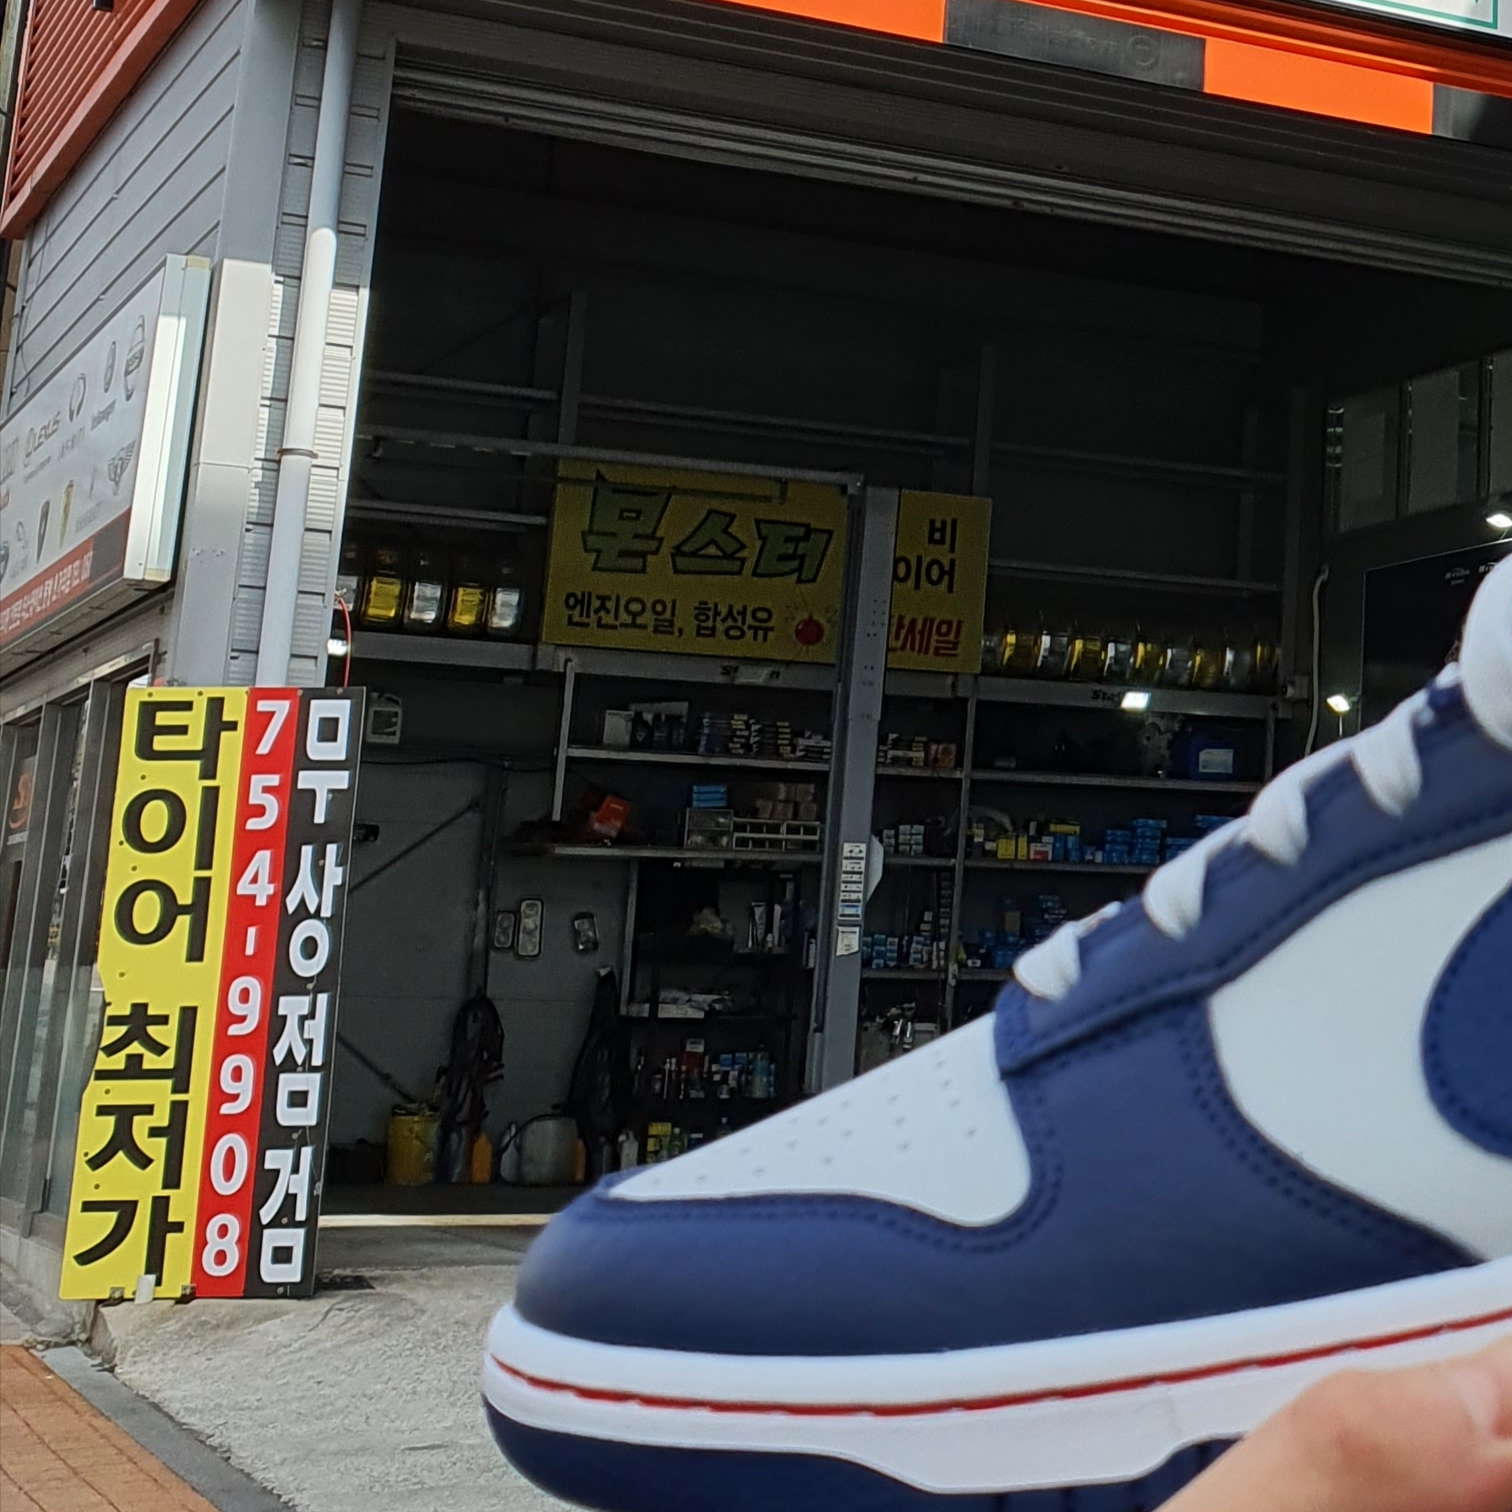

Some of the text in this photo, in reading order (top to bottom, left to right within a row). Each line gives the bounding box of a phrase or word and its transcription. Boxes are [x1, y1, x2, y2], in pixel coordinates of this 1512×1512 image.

[564, 590, 775, 643] 엔진오일, 합성유
[581, 469, 835, 585] 몬스터
[72, 696, 239, 1287] 타이어 최저가
[201, 698, 291, 1278] 754-9908
